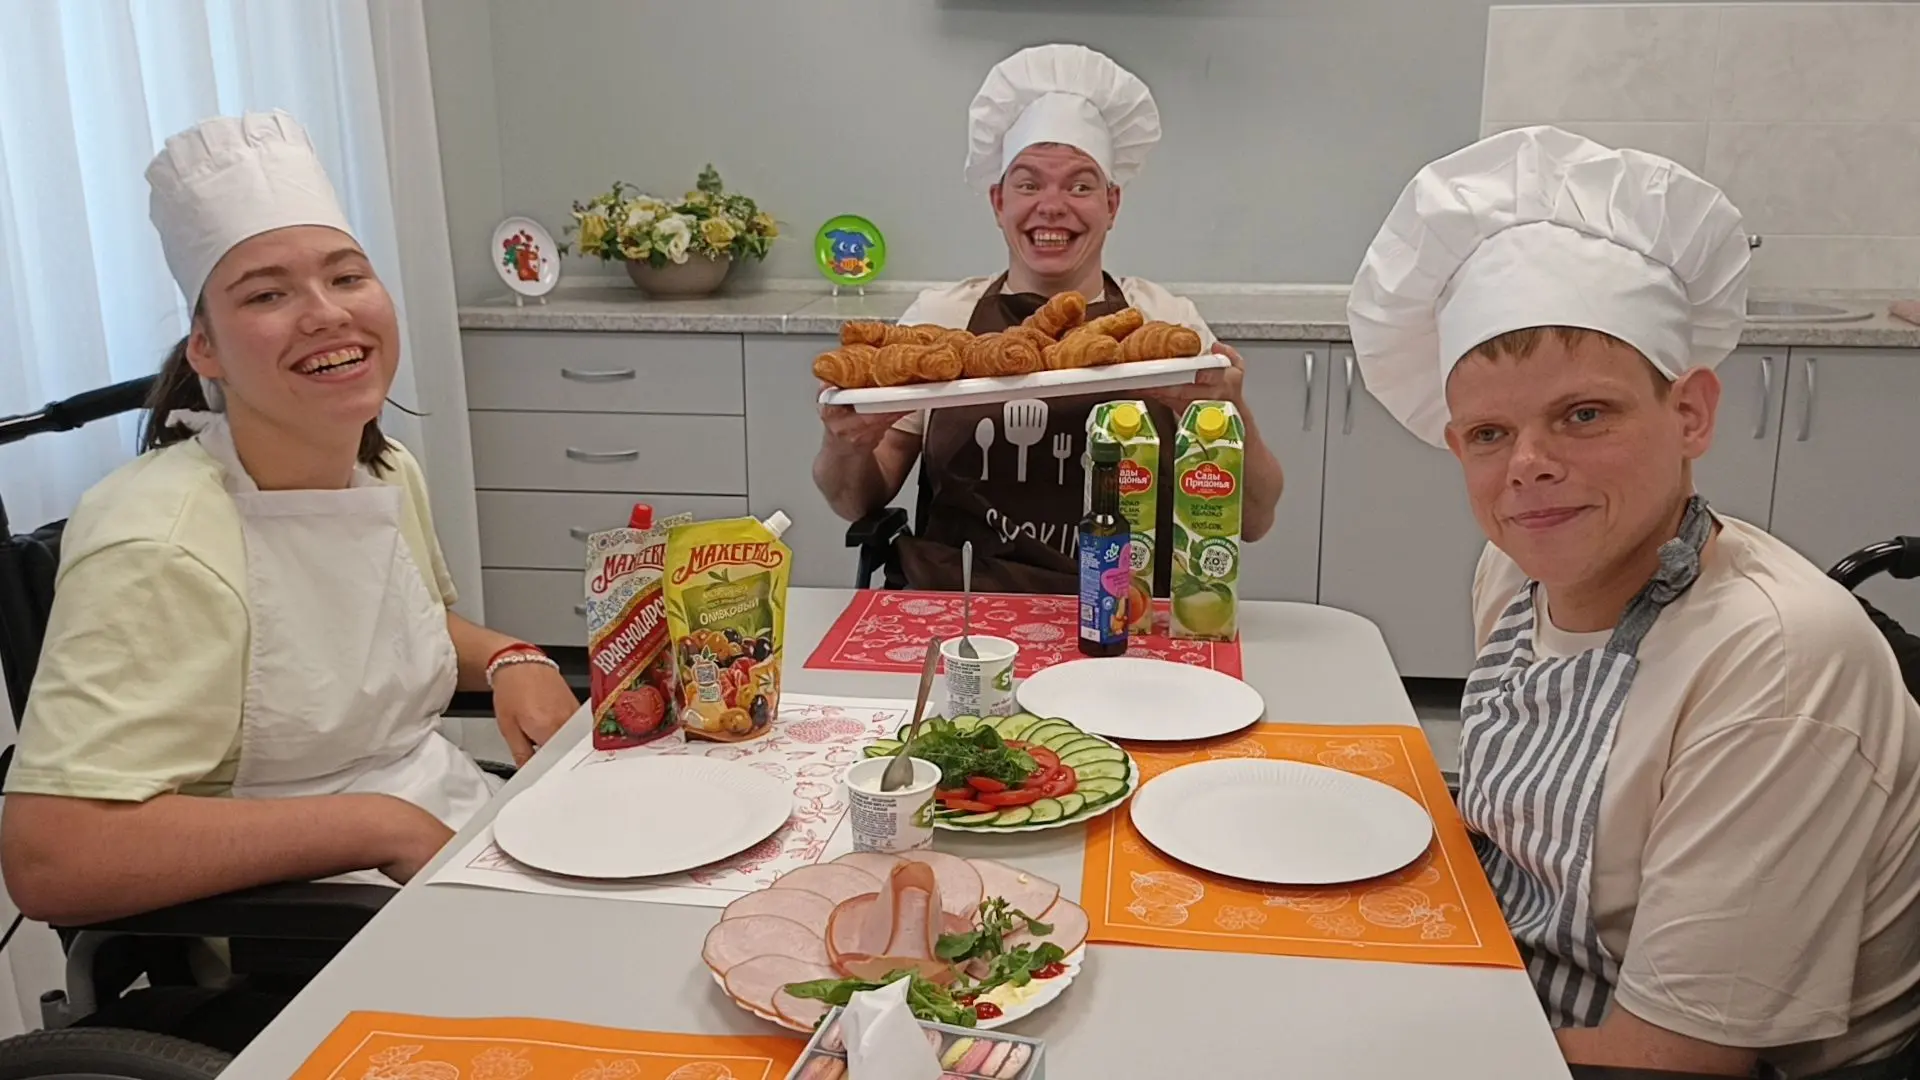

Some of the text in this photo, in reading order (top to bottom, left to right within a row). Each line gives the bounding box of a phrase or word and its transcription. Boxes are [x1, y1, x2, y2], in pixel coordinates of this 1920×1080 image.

[1119, 469, 1138, 477] ады
[1195, 470, 1220, 481] Сады
[1118, 475, 1148, 485] идонья
[1185, 476, 1230, 489] Придонья
[986, 508, 1080, 559] COOKIN
[593, 595, 668, 675] КРАСНОДАРС
